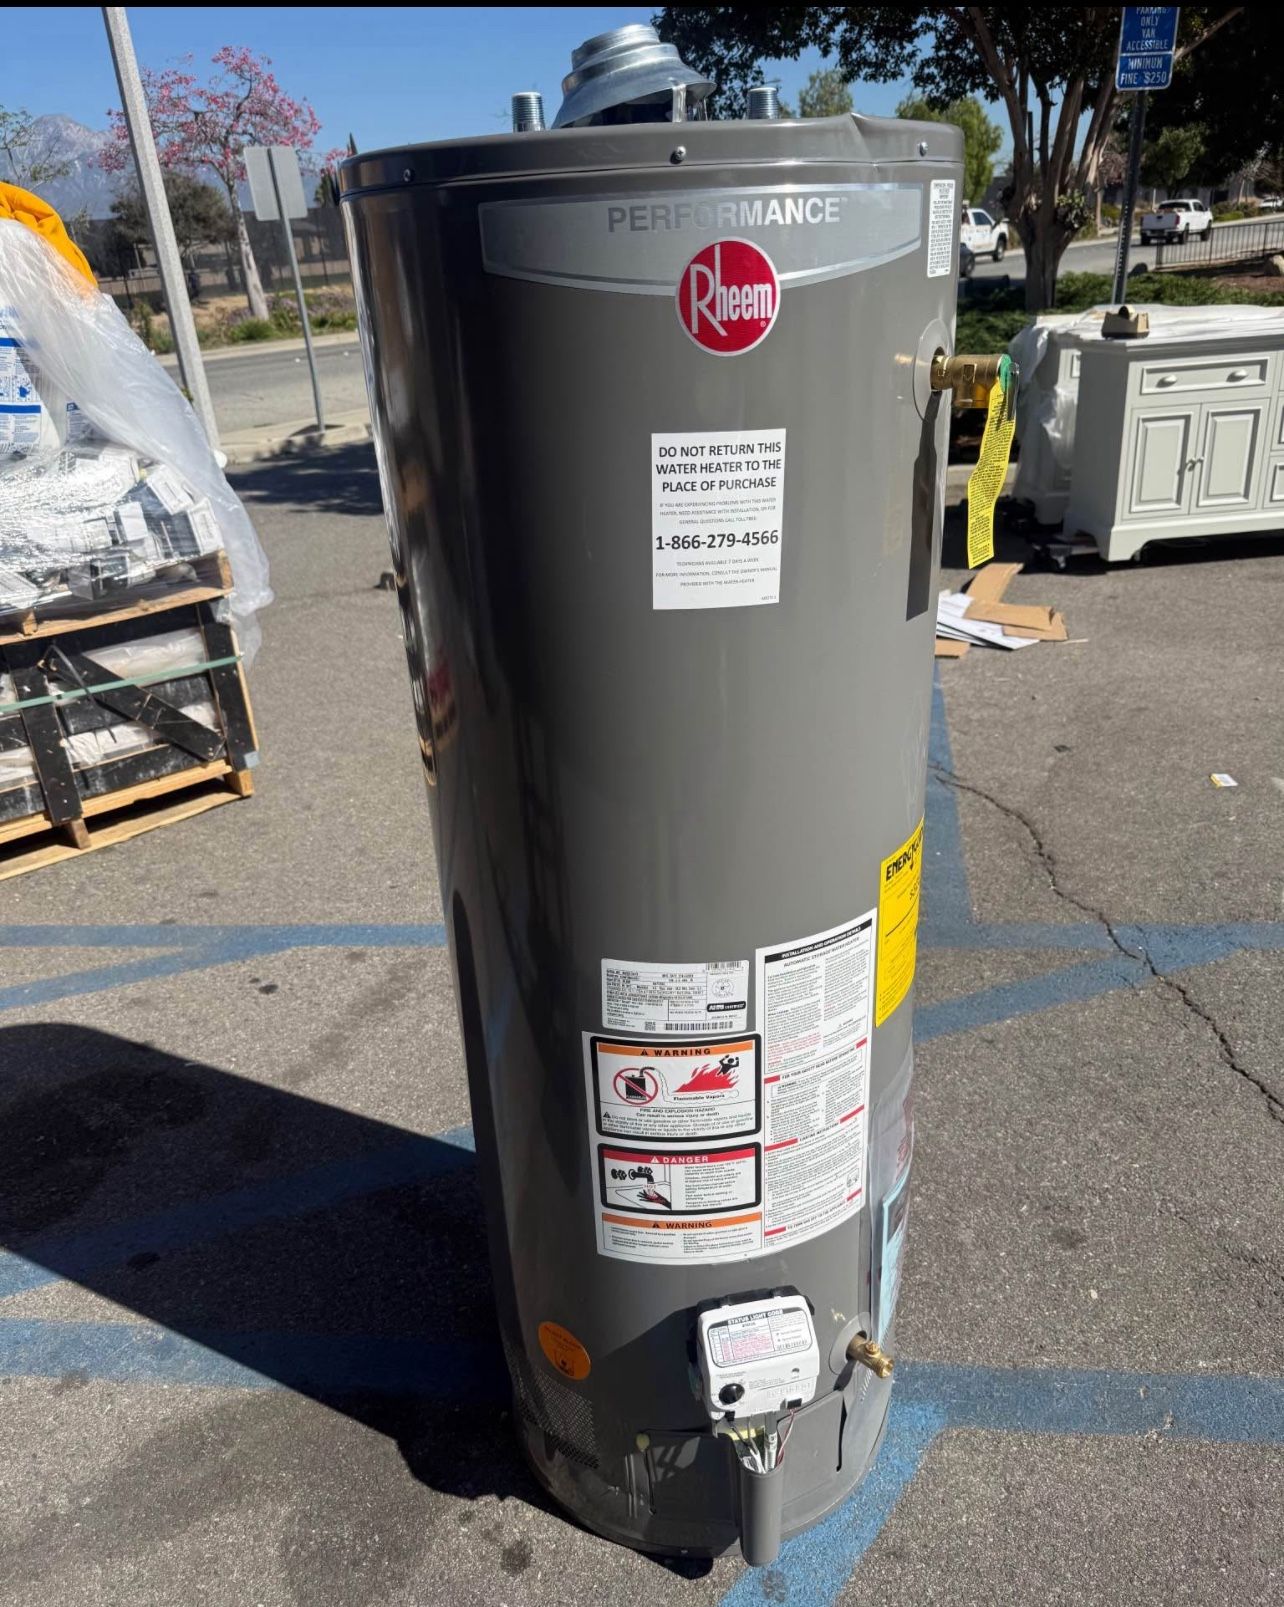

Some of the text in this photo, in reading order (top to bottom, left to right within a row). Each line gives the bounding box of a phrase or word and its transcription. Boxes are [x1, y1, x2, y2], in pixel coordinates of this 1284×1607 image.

[1140, 16, 1160, 27] ONLY
[1141, 28, 1156, 39] VAN
[1126, 39, 1169, 50] ACCESSIBLE
[1127, 56, 1163, 70] MINIMUM
[1120, 71, 1168, 85] FINE $250
[607, 197, 841, 233] PERFORMANCE
[690, 243, 774, 337] Rheem
[658, 441, 782, 458] DO NOT RETURN THIS
[656, 458, 782, 475] WATER HEATER TO THE
[662, 477, 777, 493] PLACE OF PURCHASE
[656, 529, 779, 550] 1-866-279-4566
[653, 1048, 711, 1057] WARNING
[673, 1094, 705, 1102] Flammable
[663, 1156, 709, 1164] DANGER
[665, 1221, 713, 1229] WARNING
[750, 1312, 767, 1321] LIGHT
